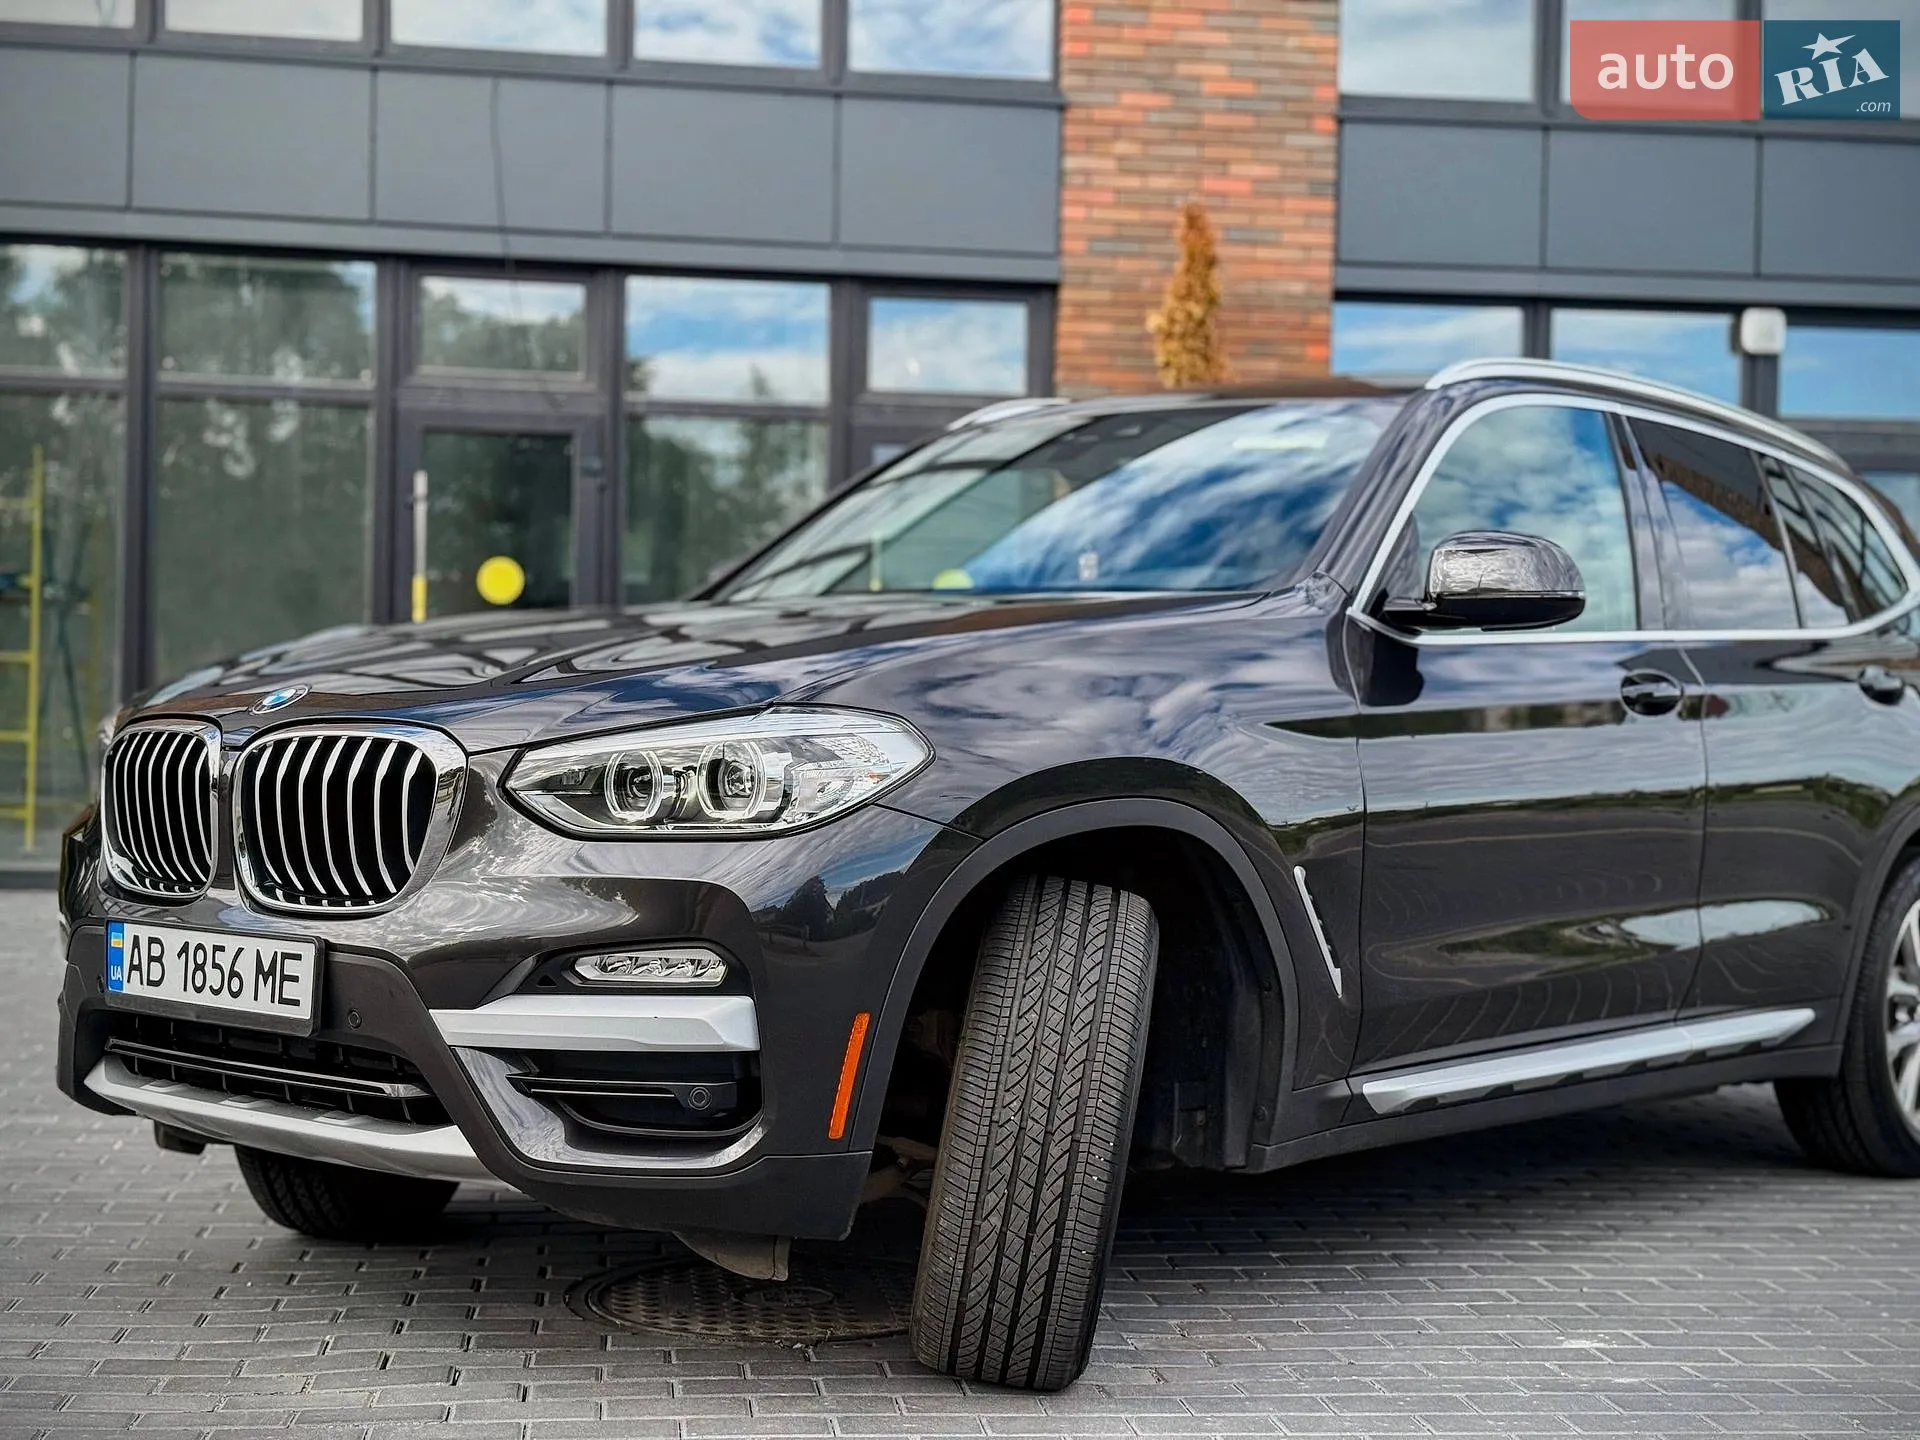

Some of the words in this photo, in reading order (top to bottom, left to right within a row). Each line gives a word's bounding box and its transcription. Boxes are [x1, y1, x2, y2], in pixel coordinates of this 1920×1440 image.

[110, 964, 123, 981] UA
[127, 934, 166, 988] AB
[176, 940, 245, 999] 1856
[253, 948, 303, 1007] ME
